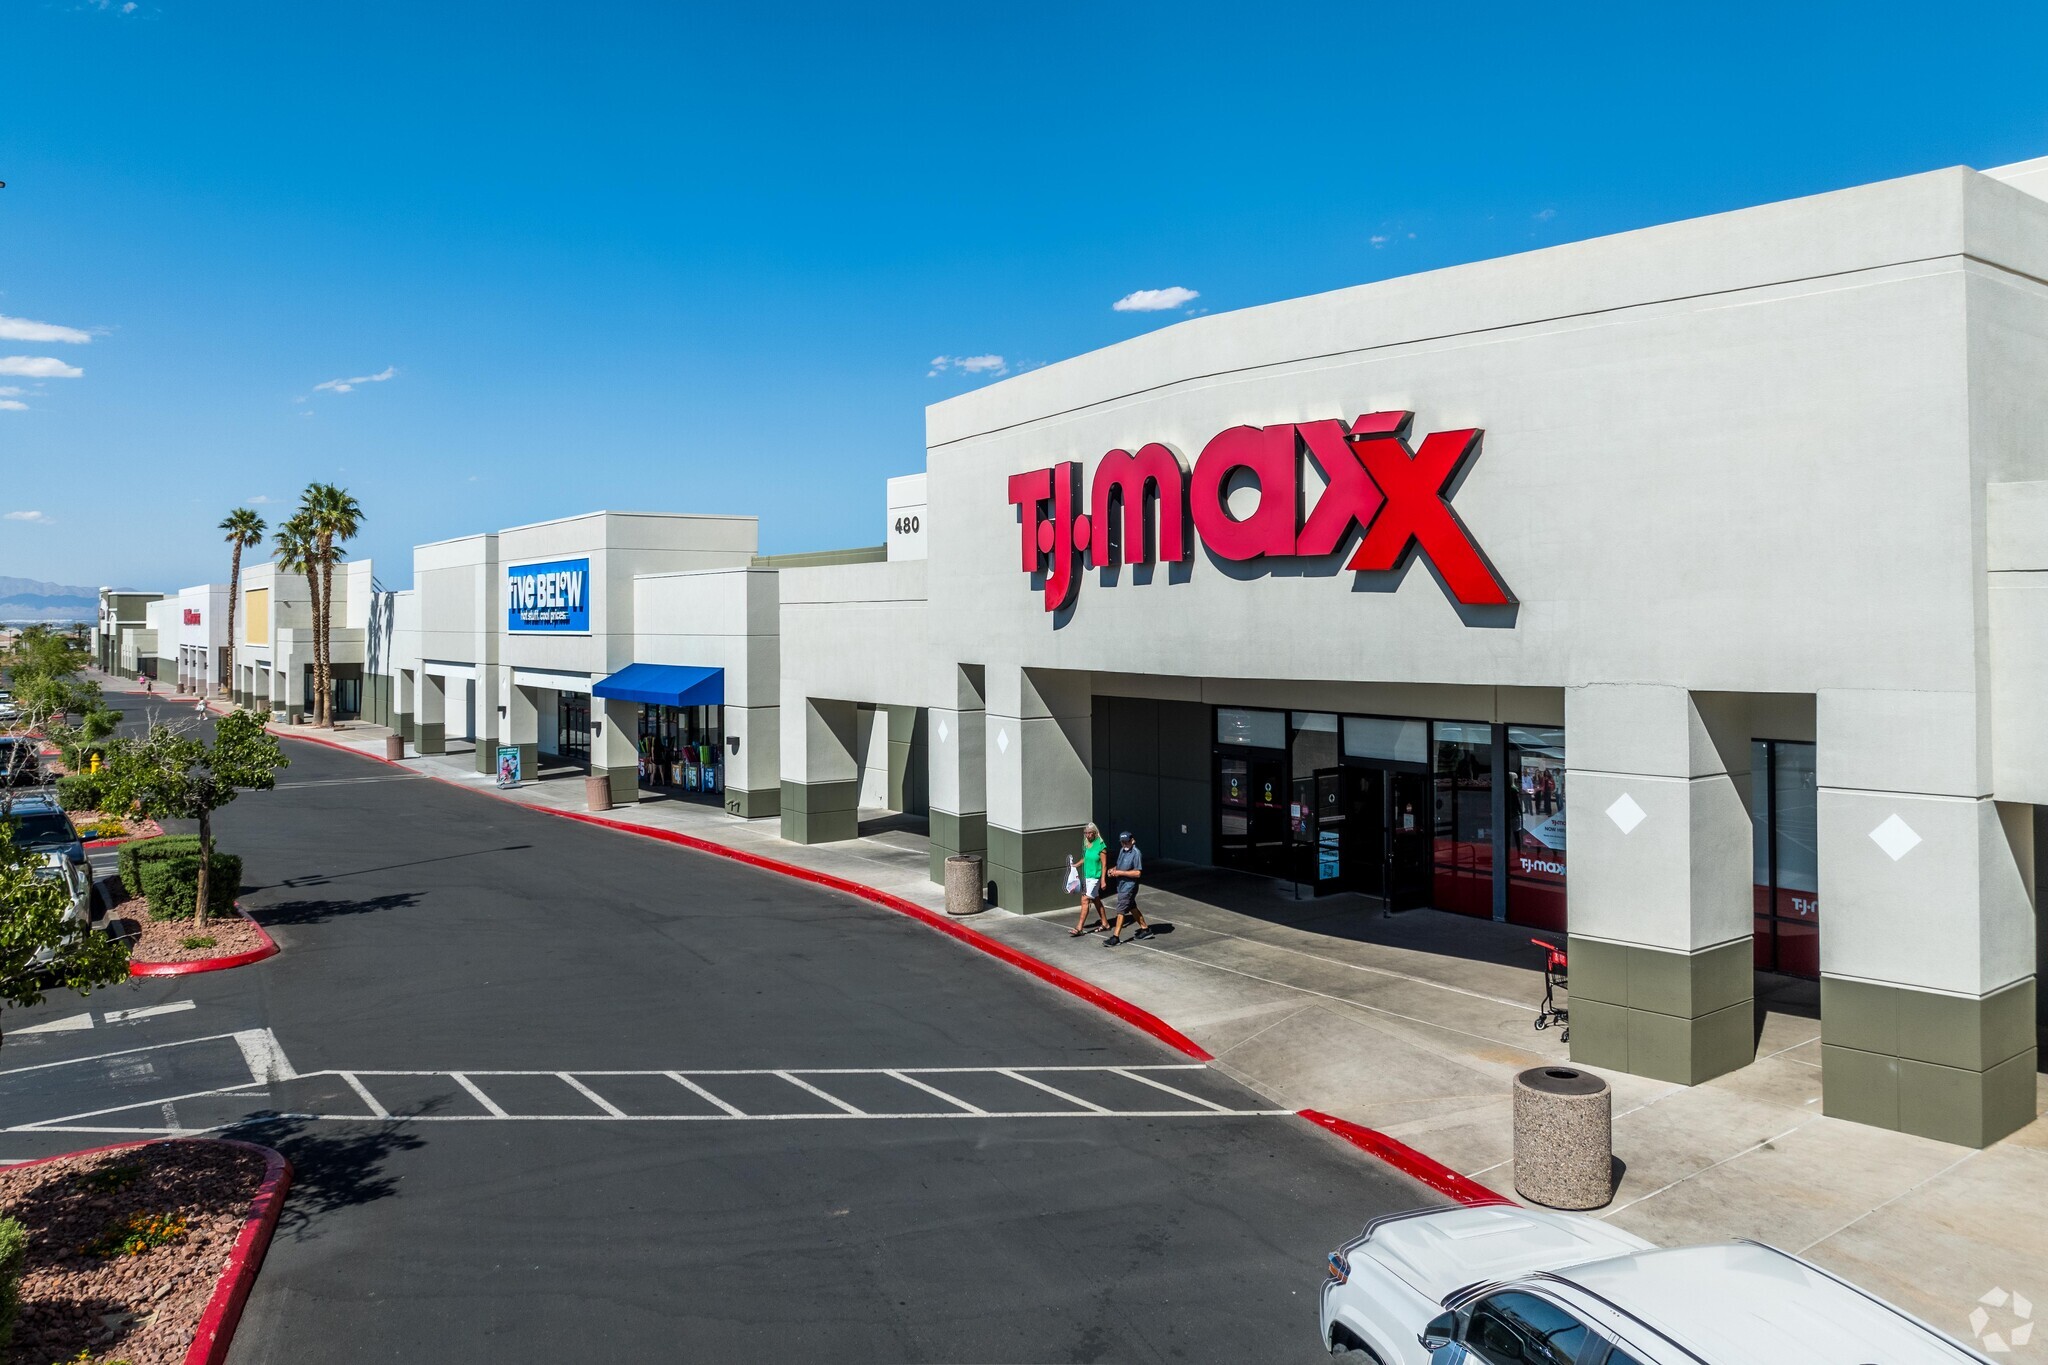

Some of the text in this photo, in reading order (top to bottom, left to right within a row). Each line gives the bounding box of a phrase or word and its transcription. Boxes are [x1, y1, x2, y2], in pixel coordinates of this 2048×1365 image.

[895, 516, 920, 535] 480
[688, 770, 697, 788] $5
[705, 771, 715, 789] $5
